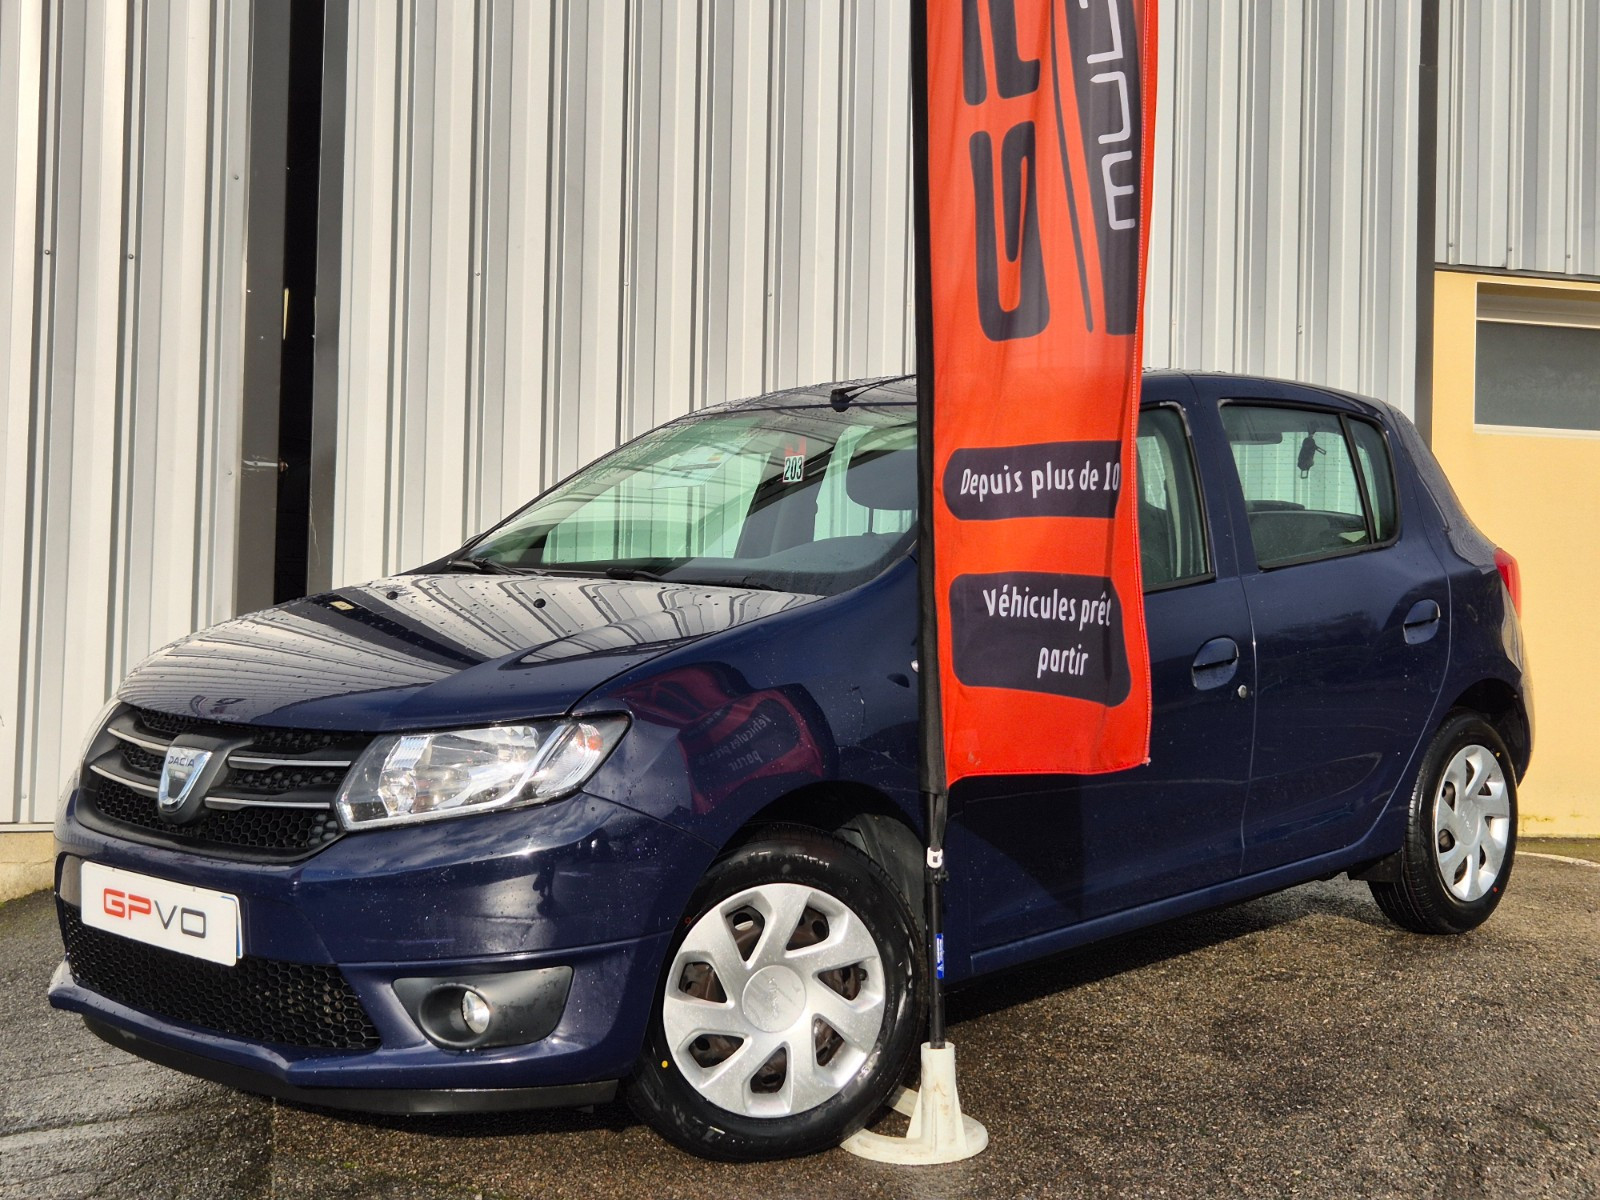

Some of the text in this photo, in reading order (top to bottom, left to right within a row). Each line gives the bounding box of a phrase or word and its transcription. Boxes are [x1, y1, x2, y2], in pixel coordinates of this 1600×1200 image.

[784, 456, 803, 481] 203
[959, 460, 1120, 502] Depuis plus de 10
[983, 584, 1077, 622] Véhicules
[1036, 644, 1089, 679] partir
[168, 755, 195, 768] DACIA
